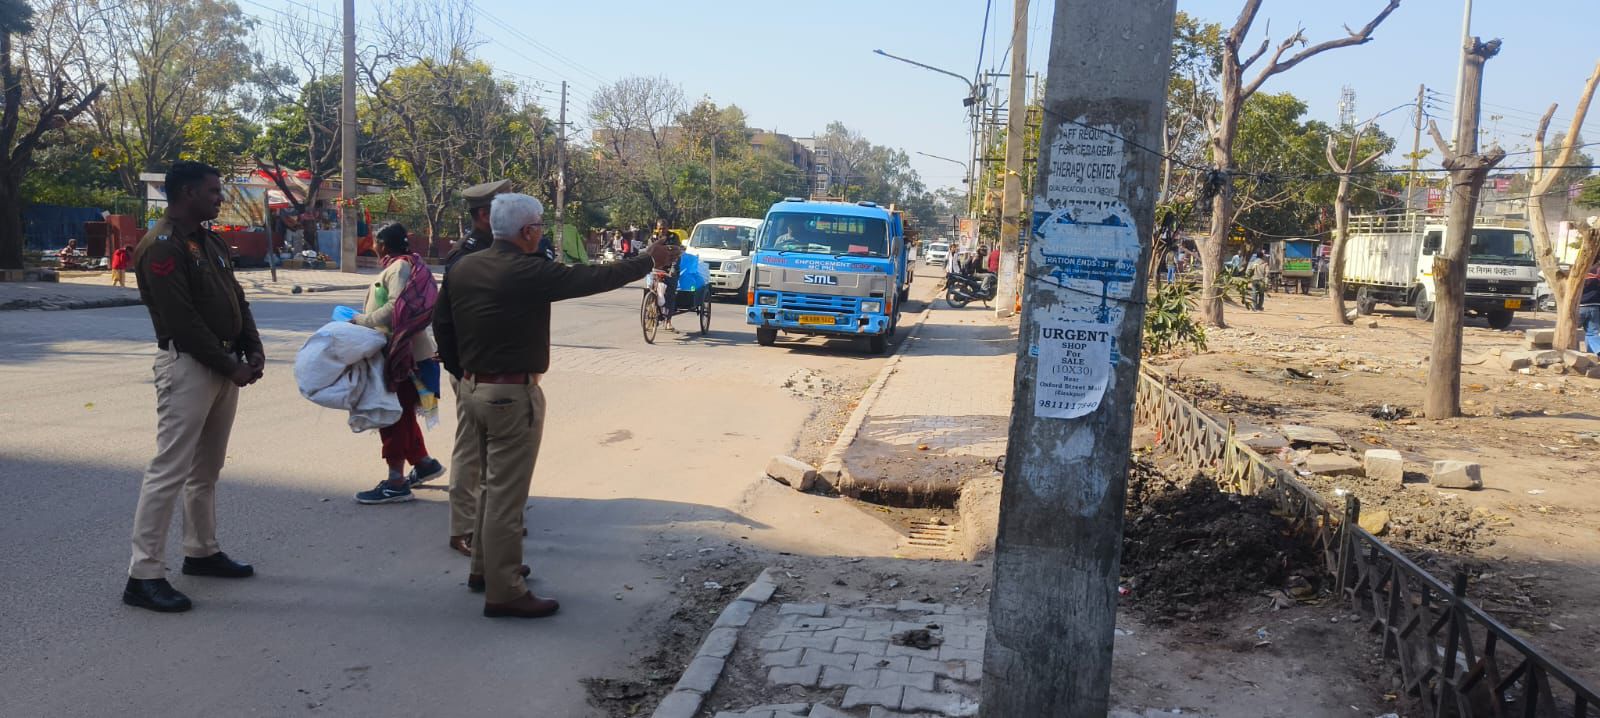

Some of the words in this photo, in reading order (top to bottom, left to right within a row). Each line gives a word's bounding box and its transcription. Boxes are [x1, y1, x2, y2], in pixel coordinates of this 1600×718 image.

[1059, 127, 1077, 139] AFF
[1058, 143, 1075, 155] FOR
[1076, 144, 1113, 157] CERAGEM
[1052, 161, 1086, 178] THERAPY
[1086, 163, 1116, 179] CENTER
[795, 258, 850, 268] ENFORCEMENT
[804, 274, 836, 285] SML
[1042, 327, 1108, 342] URGENT
[1062, 342, 1087, 350] SHOP
[1066, 350, 1081, 358] For
[1061, 357, 1085, 366] SALE
[1053, 365, 1093, 376] (10X30)
[1040, 381, 1063, 389] Oxford
[1064, 383, 1085, 391] Street
